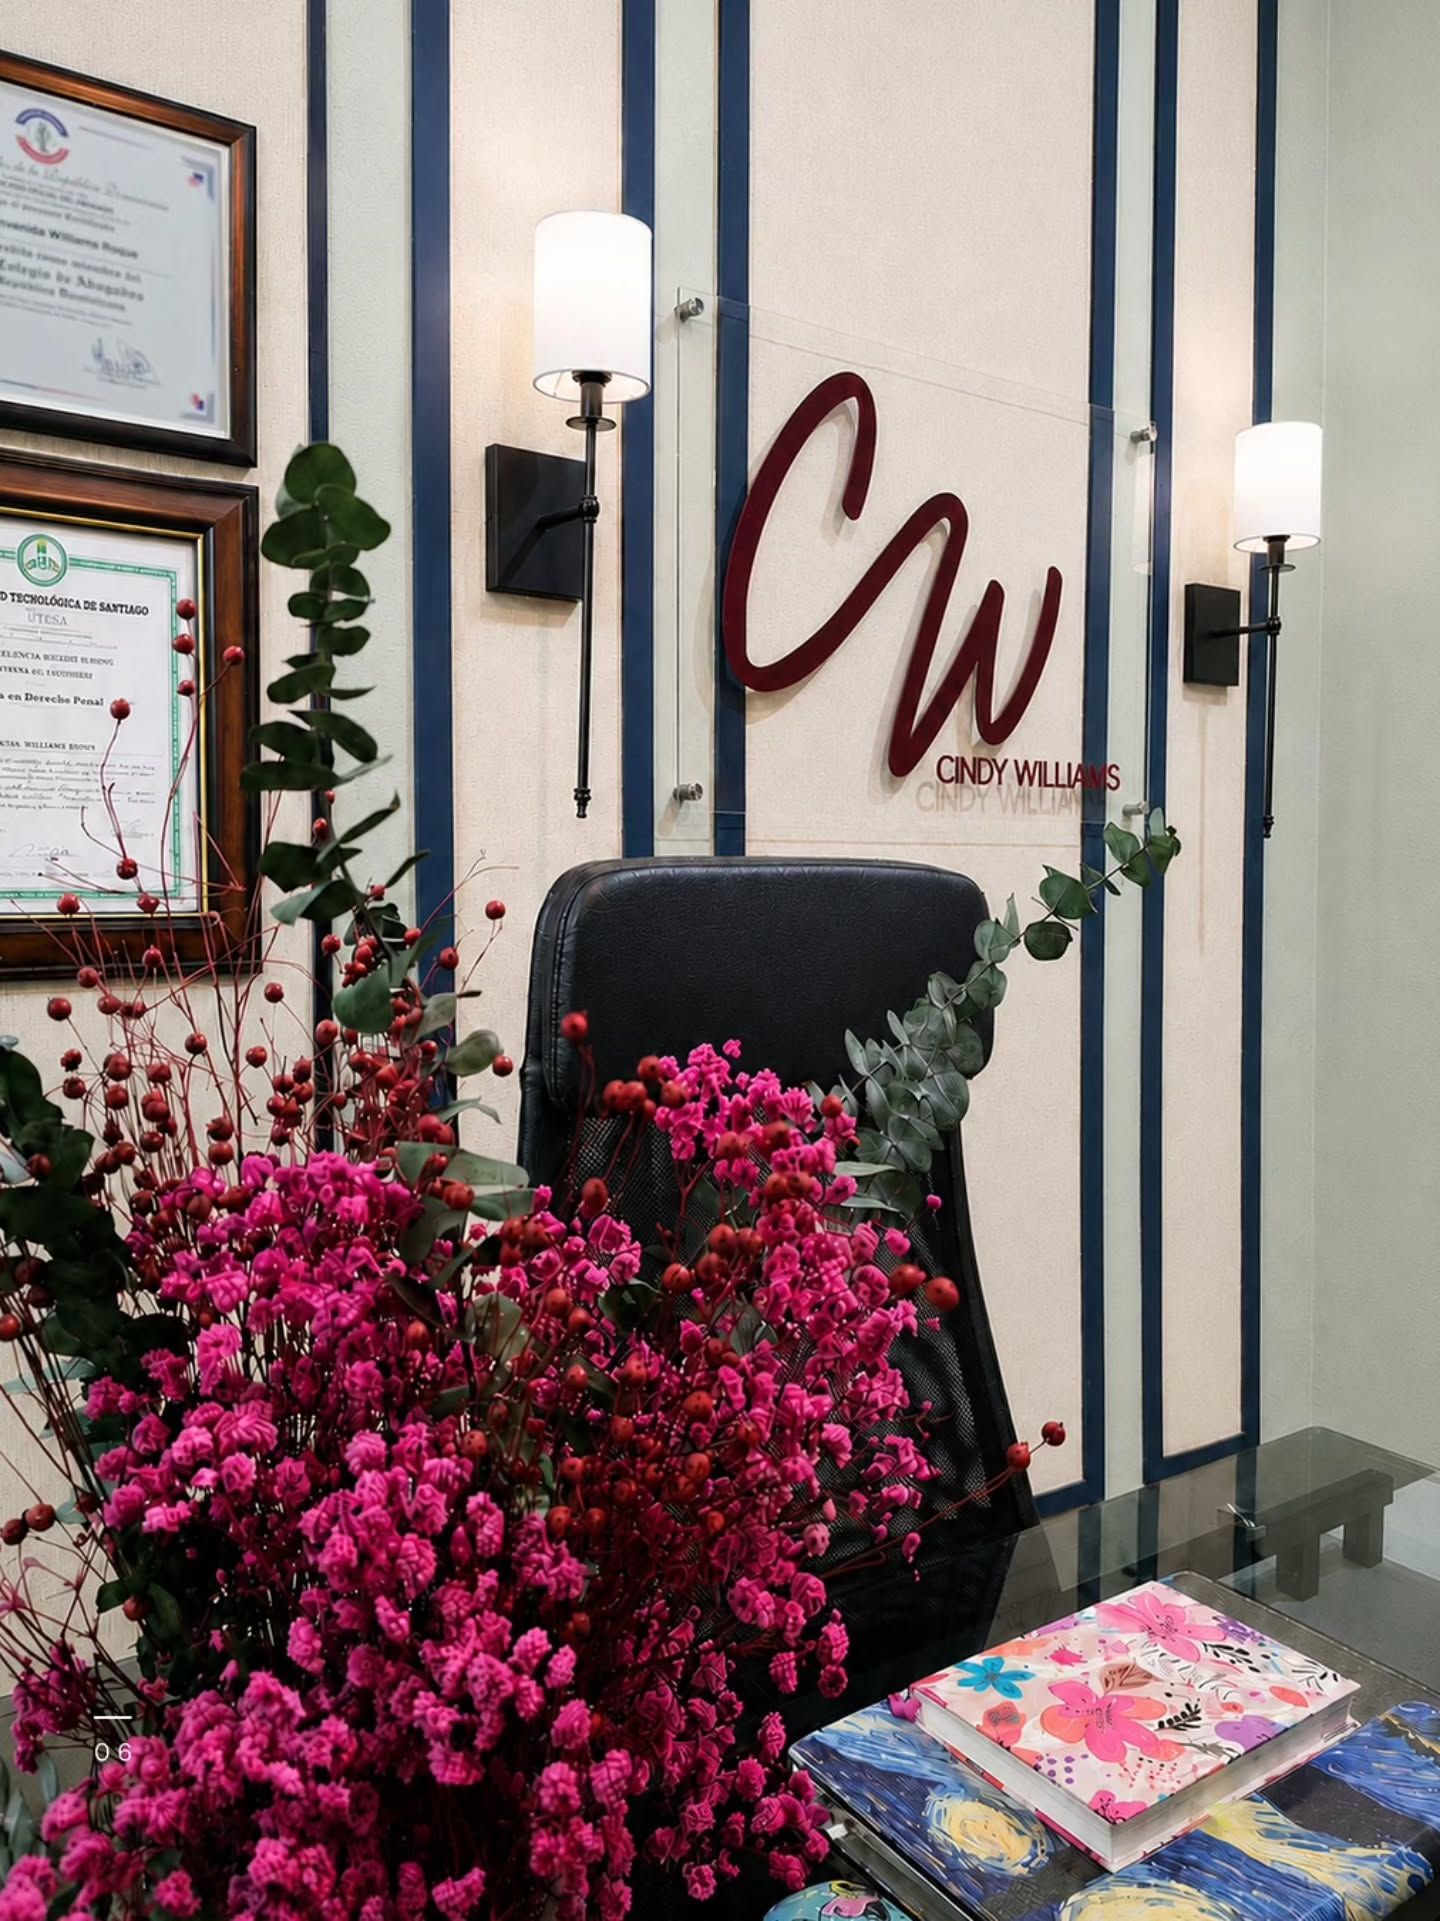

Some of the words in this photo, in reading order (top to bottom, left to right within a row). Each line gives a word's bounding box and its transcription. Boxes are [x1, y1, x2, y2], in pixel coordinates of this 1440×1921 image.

[10, 592, 81, 610] TECNOLÓGICA
[84, 600, 97, 611] DE
[99, 601, 149, 616] SANTIAGO
[8, 694, 22, 702] en
[24, 692, 70, 704] Derecho
[73, 696, 104, 707] Penal
[936, 755, 1008, 786] CINDY
[1014, 760, 1121, 792] WILLIAMS
